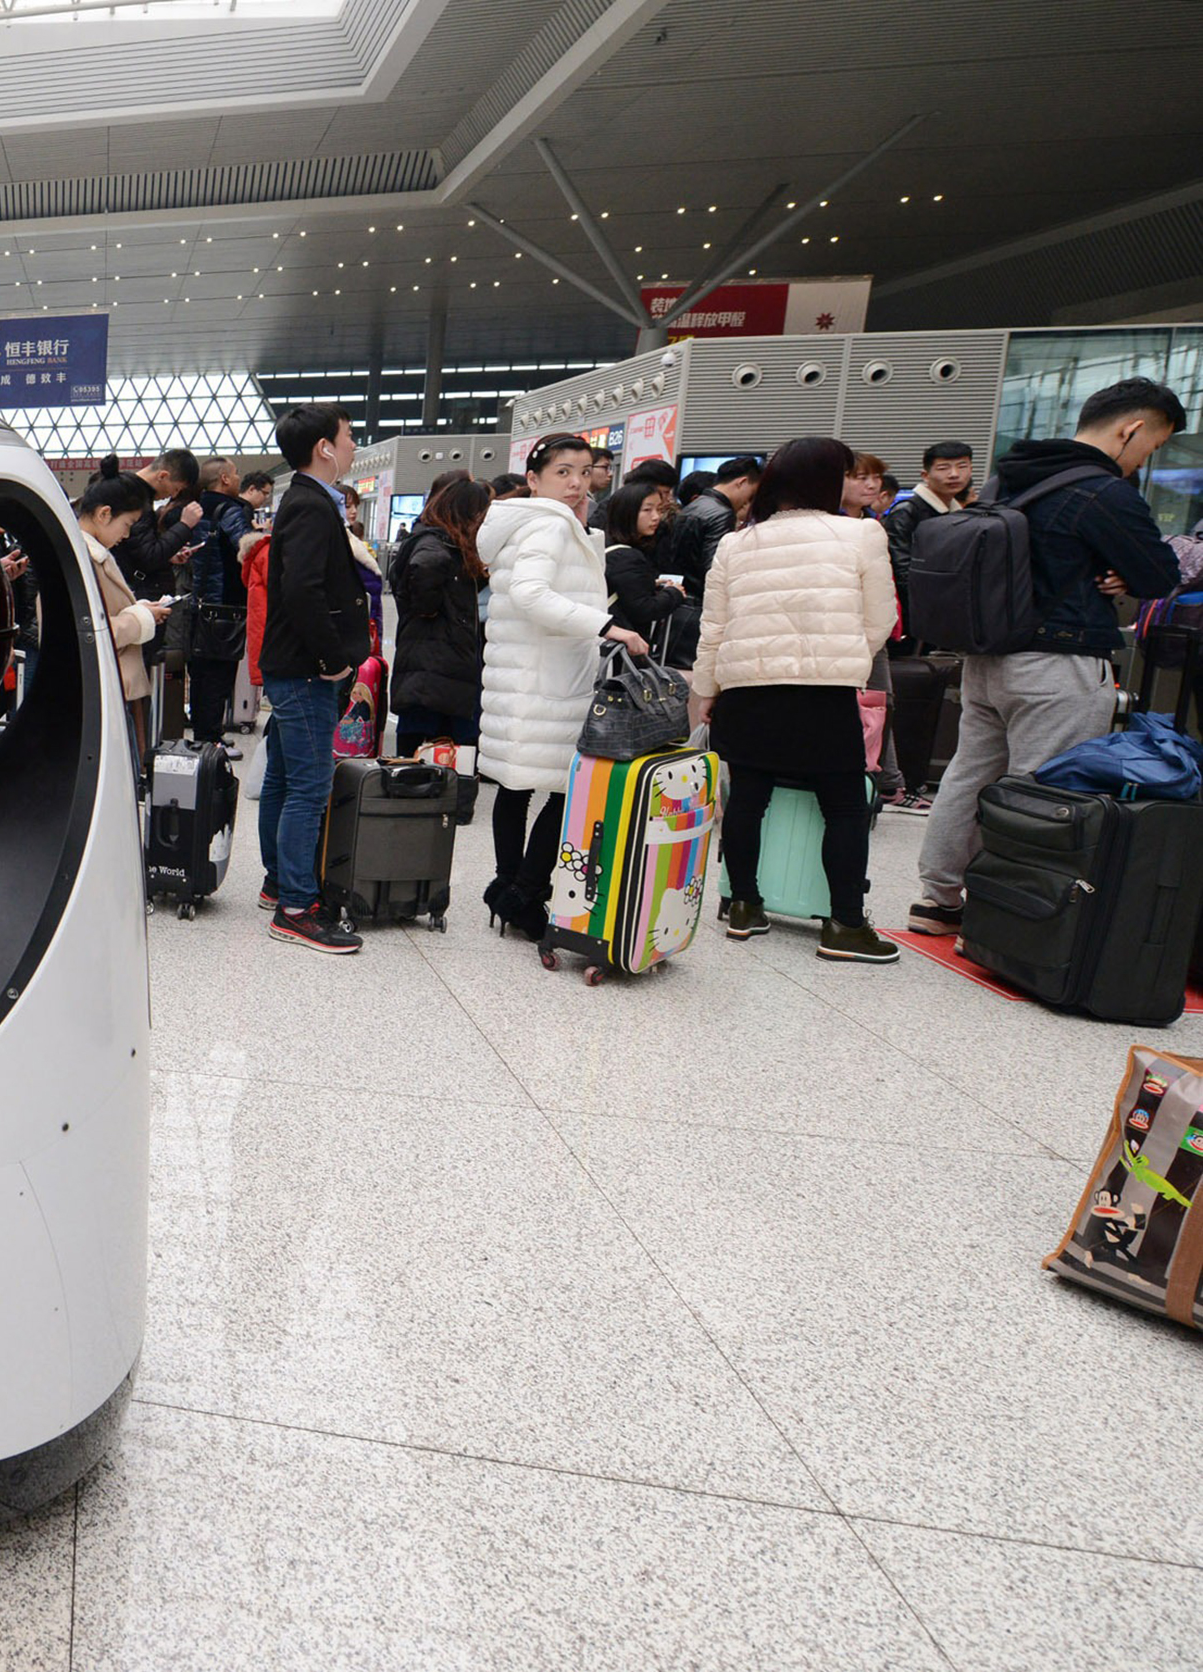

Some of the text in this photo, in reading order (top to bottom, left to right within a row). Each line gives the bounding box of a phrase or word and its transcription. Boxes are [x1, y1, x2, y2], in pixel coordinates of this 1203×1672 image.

[4, 339, 70, 358] 恒丰银行
[6, 358, 45, 366] HENGFENG
[25, 372, 67, 385] 德致丰
[609, 430, 623, 446] B26
[158, 866, 185, 877] World
